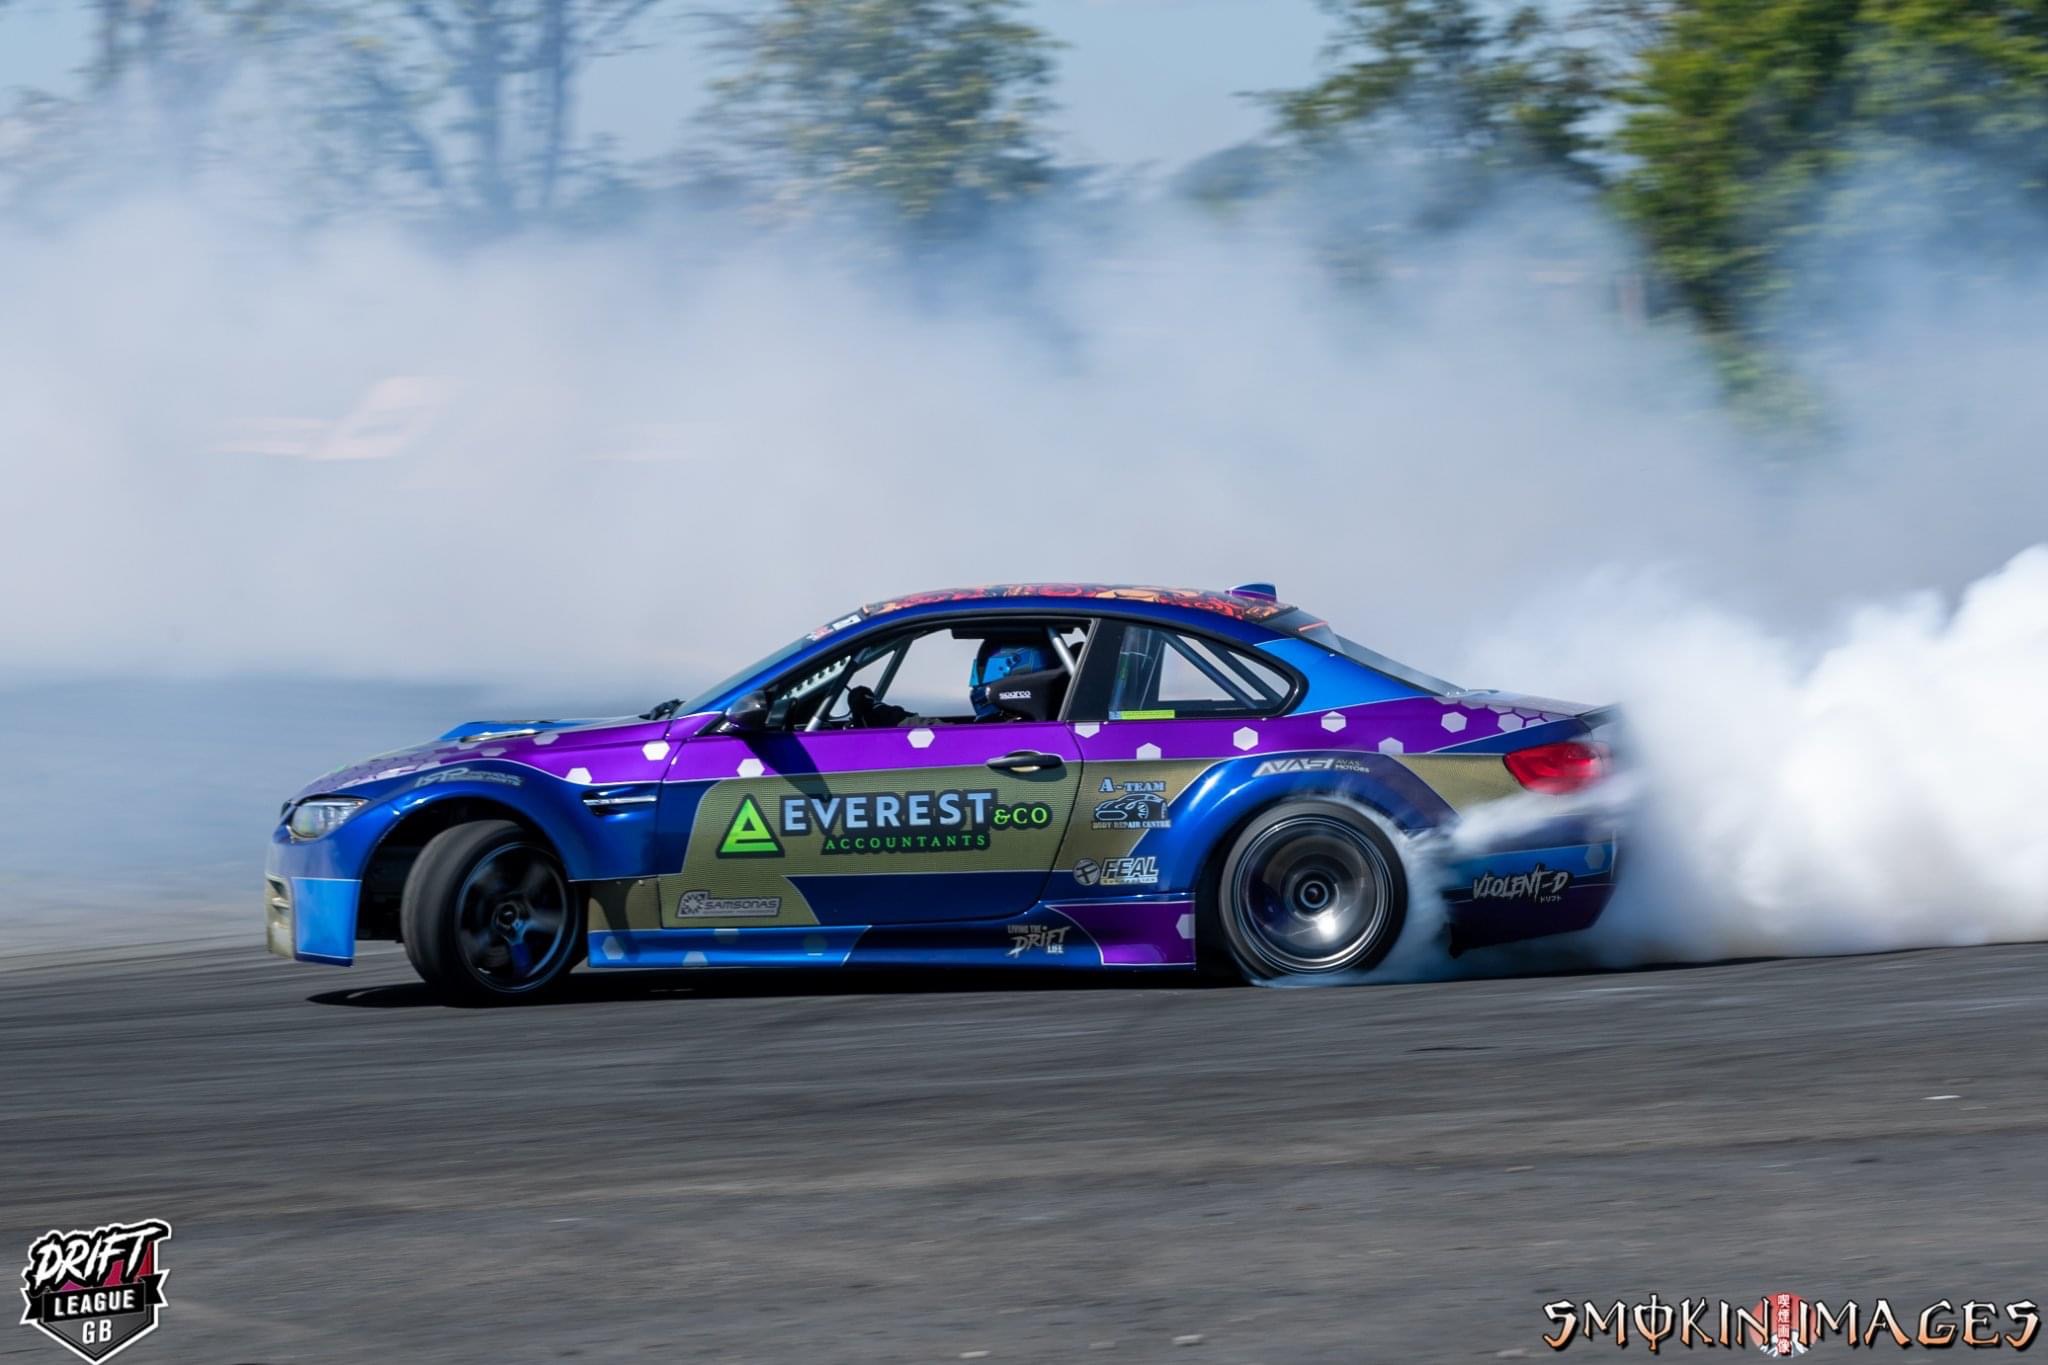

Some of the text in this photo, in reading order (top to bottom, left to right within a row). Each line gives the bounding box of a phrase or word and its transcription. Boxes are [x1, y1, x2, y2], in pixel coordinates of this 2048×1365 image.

[784, 793, 1048, 831] EVEREST &CO
[1114, 821, 1141, 829] REPAIR
[825, 835, 986, 850] ACCOUNTANTS
[1101, 857, 1158, 878] FEAL
[1473, 863, 1569, 898] VIOLENT-D
[704, 900, 777, 910] SAMSONAS
[1007, 925, 1072, 958] DRIFT
[1047, 945, 1064, 953] LIFE
